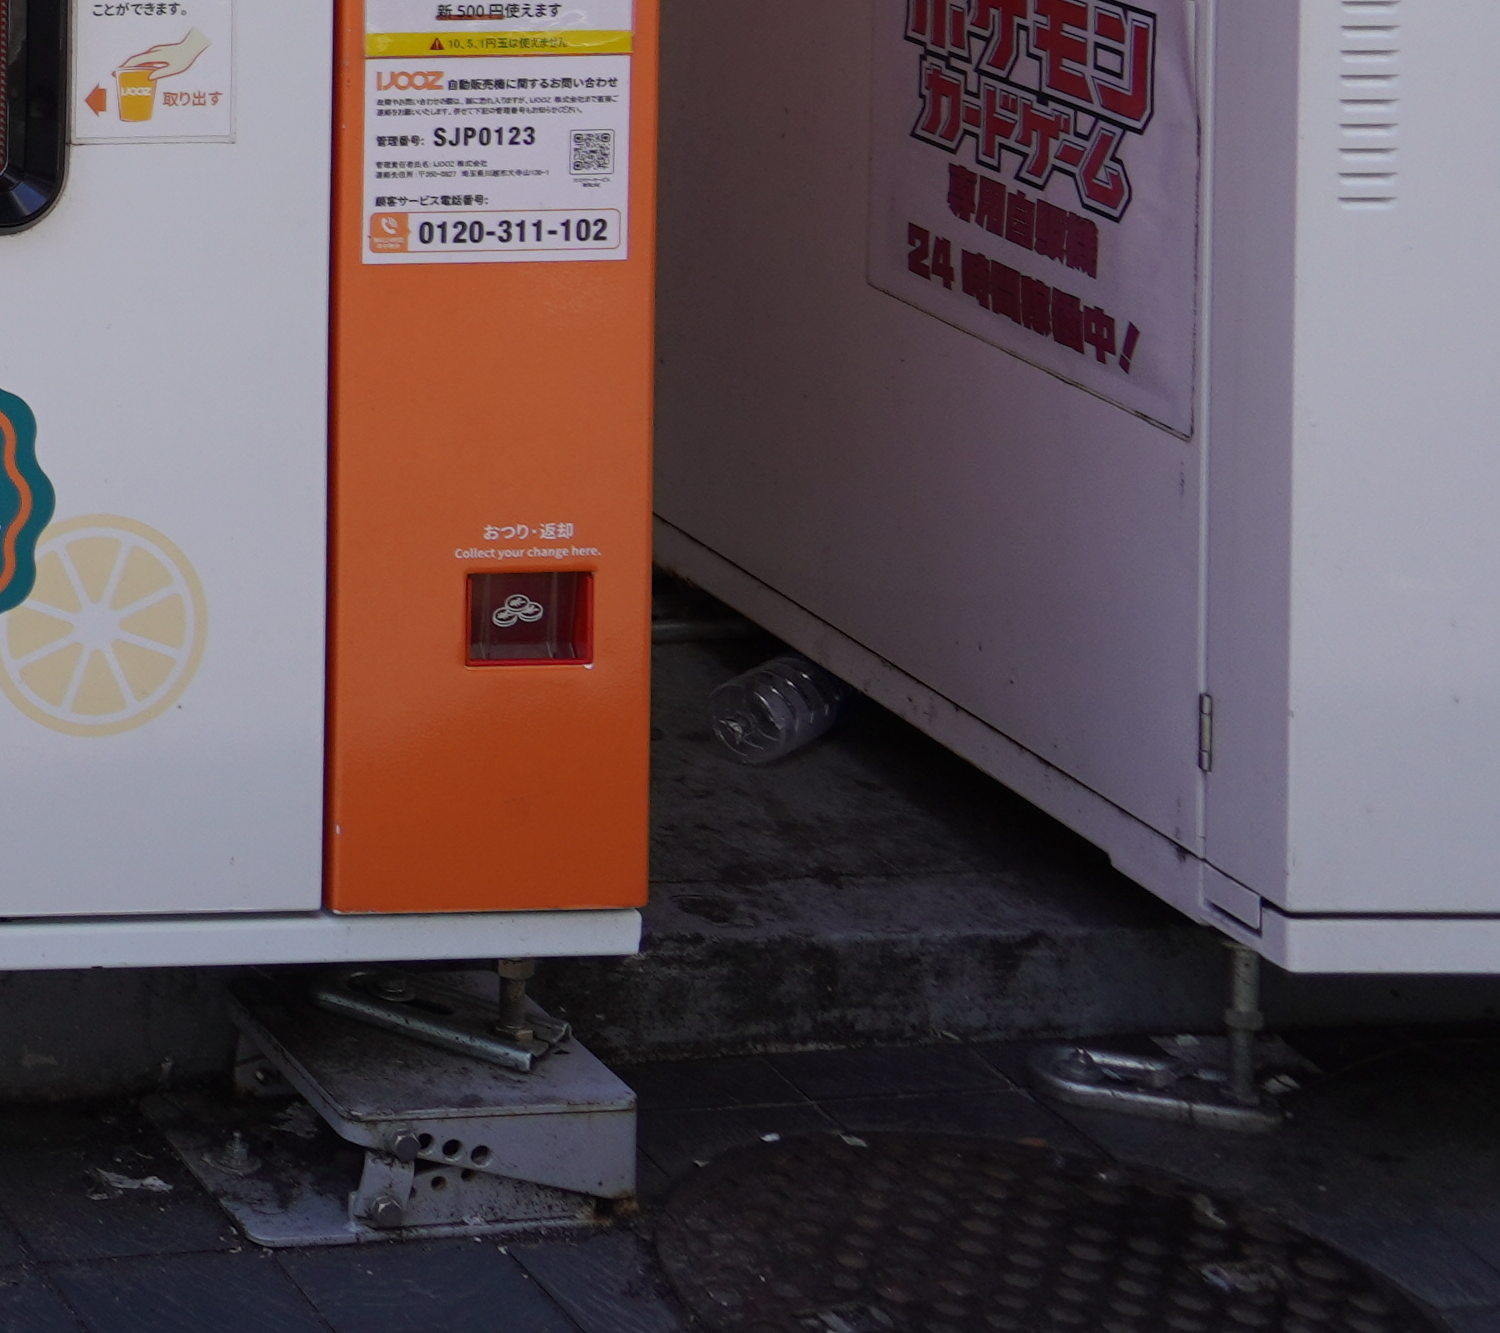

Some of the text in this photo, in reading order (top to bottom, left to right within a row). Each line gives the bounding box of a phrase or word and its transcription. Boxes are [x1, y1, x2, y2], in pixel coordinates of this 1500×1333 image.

[162, 91, 222, 106] 取り出す
[433, 126, 536, 147] SJP0123
[911, 56, 1131, 222] カードゲーム
[419, 219, 608, 244] 0120-311-102
[455, 546, 601, 560] Collect your change here.
